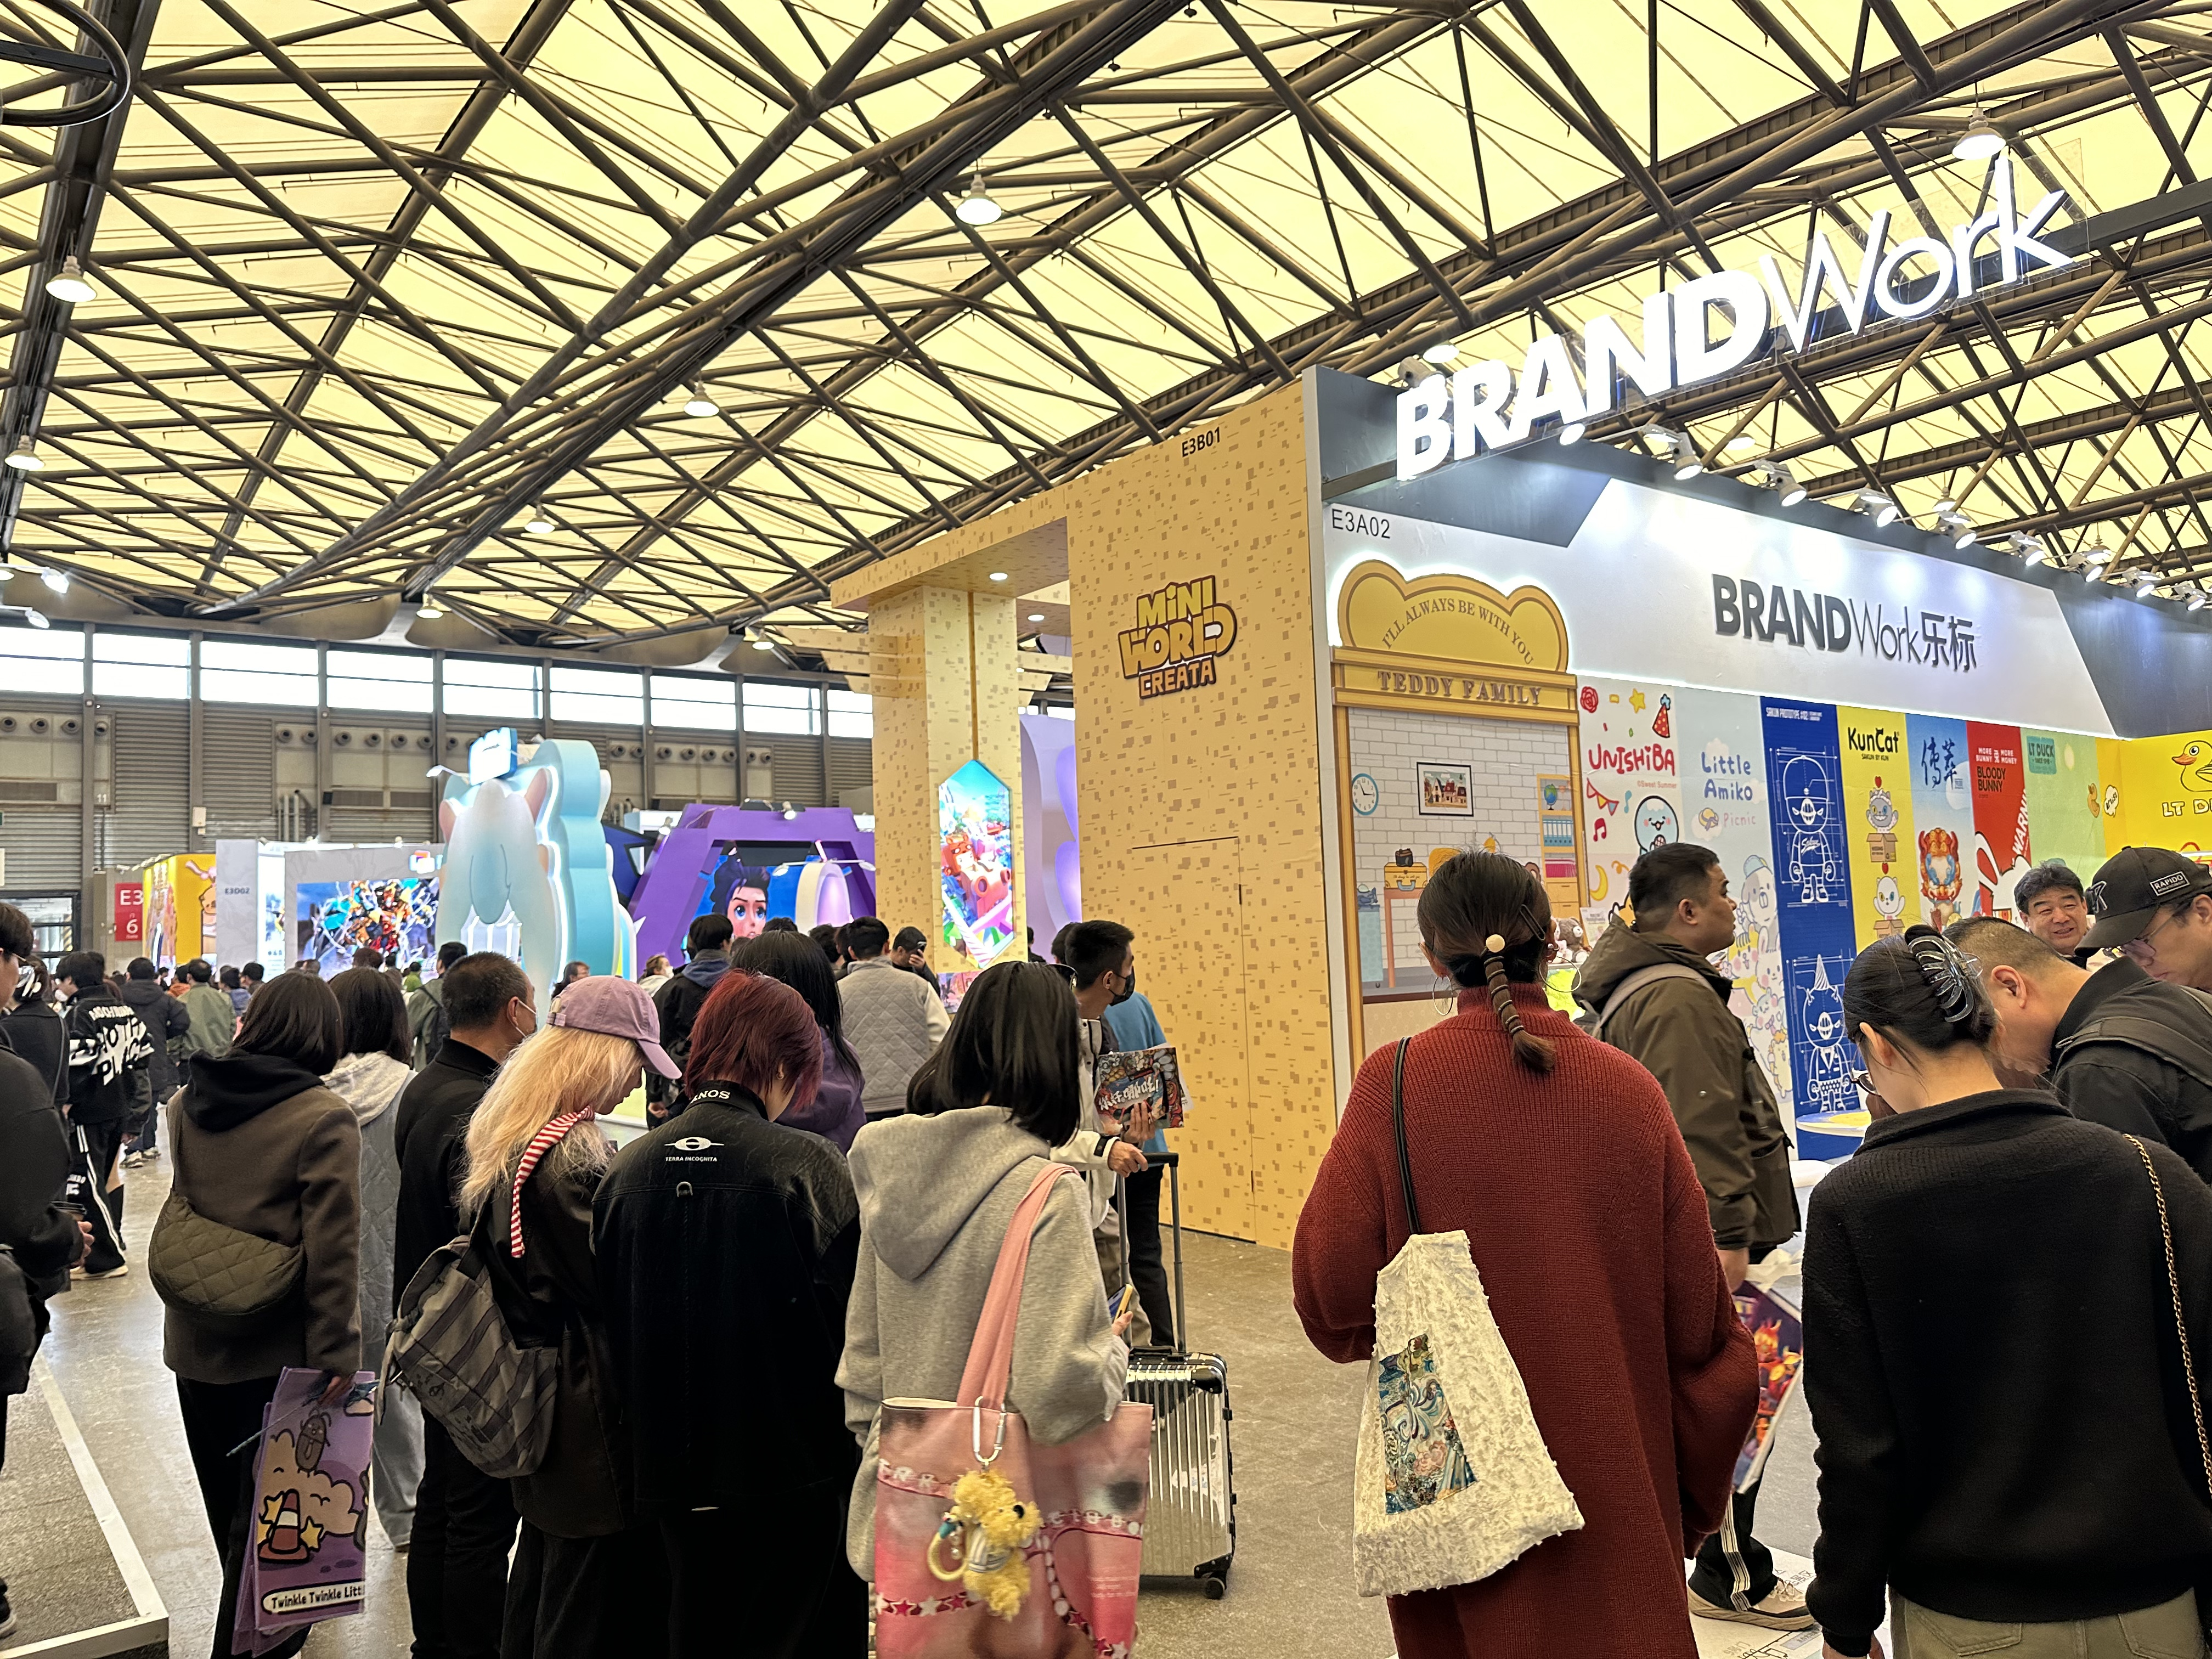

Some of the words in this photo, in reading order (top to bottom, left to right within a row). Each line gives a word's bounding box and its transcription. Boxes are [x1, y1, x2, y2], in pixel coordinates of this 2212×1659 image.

[1182, 426, 1221, 458] E3B01
[1331, 509, 1391, 539] E3A02
[1382, 620, 1406, 650] I'LL
[1405, 598, 1455, 625] ALWAYS
[1458, 600, 1475, 616] BE
[1478, 606, 1510, 637] WITH
[1510, 630, 1534, 665] YOU
[1138, 658, 1216, 699] CREATA
[1378, 670, 1454, 697] TEDDY
[1462, 680, 1542, 706] FAMILY
[1976, 754, 1993, 763] BUNNY
[2028, 742, 2035, 756] LT
[2036, 743, 2054, 758] DUCK
[1701, 752, 1751, 775] Little
[1977, 765, 2006, 780] BLOODY
[1704, 778, 1753, 802] Amiko
[1978, 779, 2003, 793] BUNNY
[2162, 800, 2185, 817] LT
[2193, 798, 2212, 814] D
[1723, 812, 1756, 827] Picnic
[2154, 874, 2183, 889] RAPIDO
[120, 890, 143, 906] E3
[224, 887, 250, 895] E3D02
[126, 918, 138, 934] 6
[272, 1593, 307, 1609] Twinkle
[309, 1588, 341, 1603] Twinkle
[344, 1585, 362, 1598] Litt
